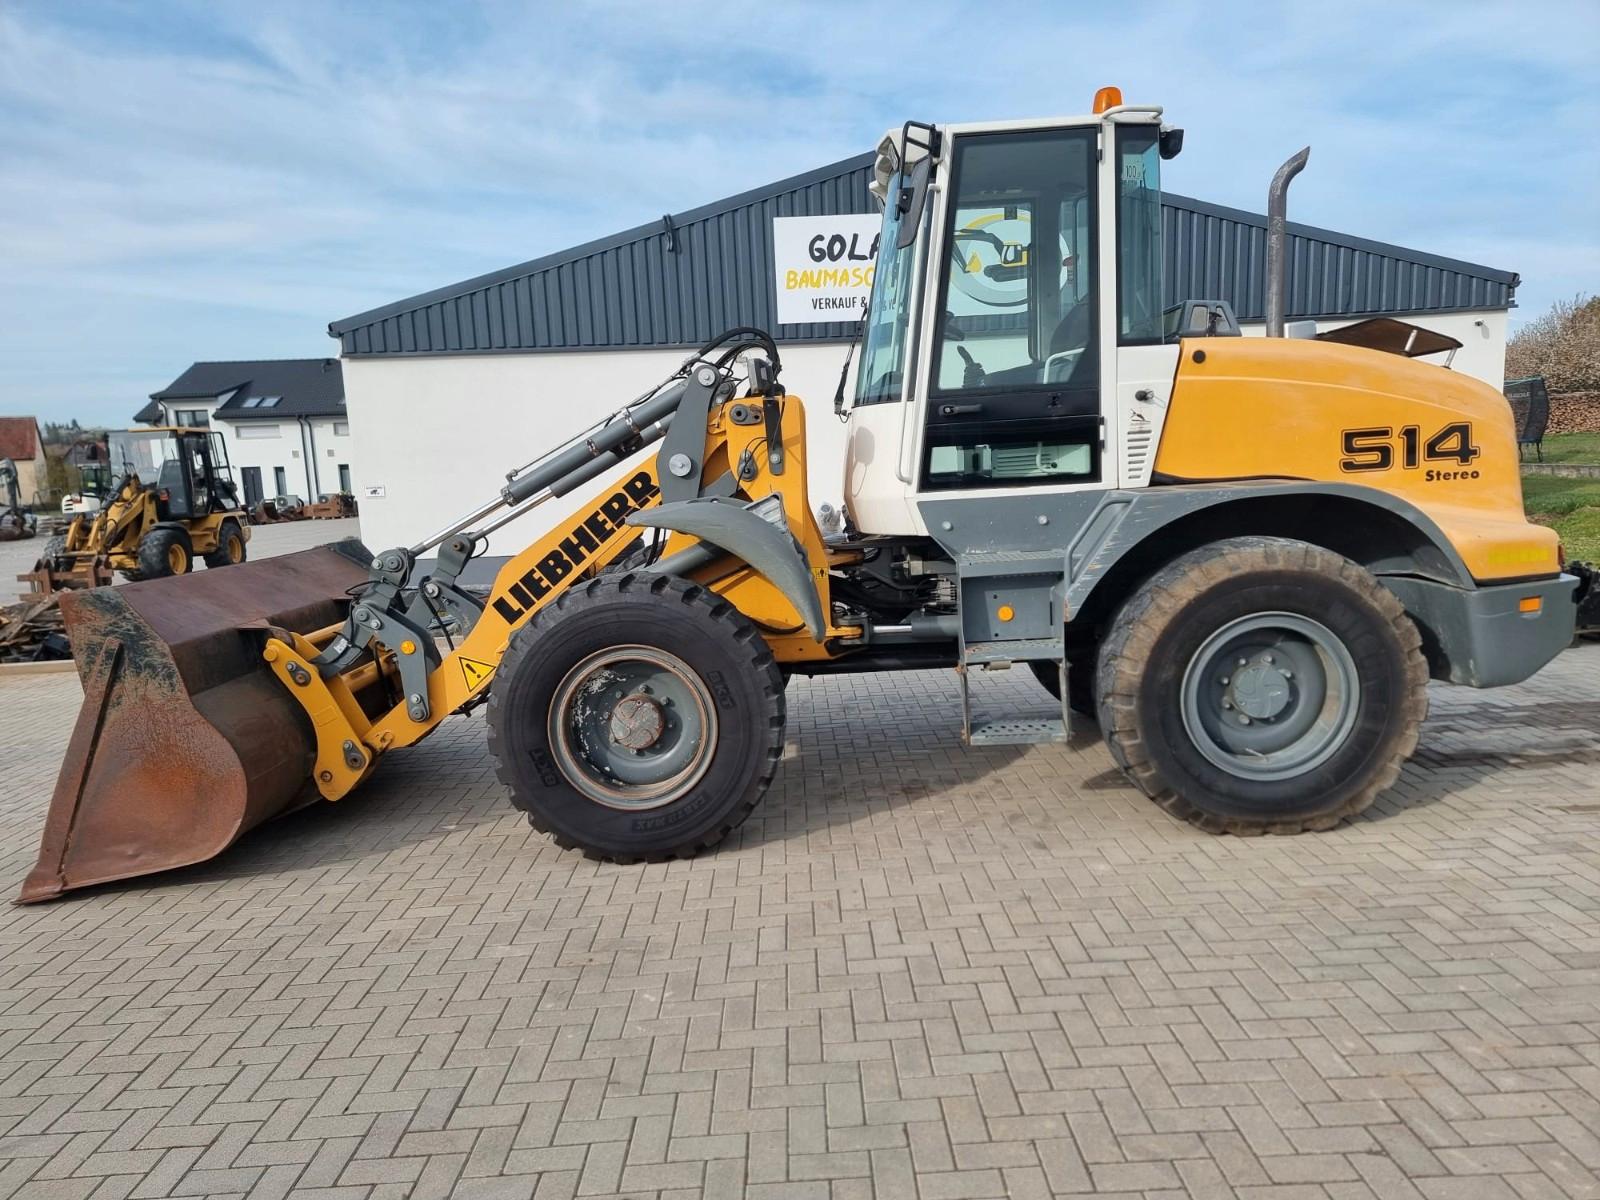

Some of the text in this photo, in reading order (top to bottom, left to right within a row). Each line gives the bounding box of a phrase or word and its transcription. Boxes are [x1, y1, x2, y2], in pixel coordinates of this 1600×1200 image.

[785, 266, 875, 290] BAUMASC
[811, 296, 858, 310] VERKAUF
[860, 296, 867, 308] &
[1339, 421, 1480, 473] 514
[1425, 470, 1480, 481] Stereo
[492, 471, 660, 625] LIEBHERR
[706, 671, 736, 709] BKT
